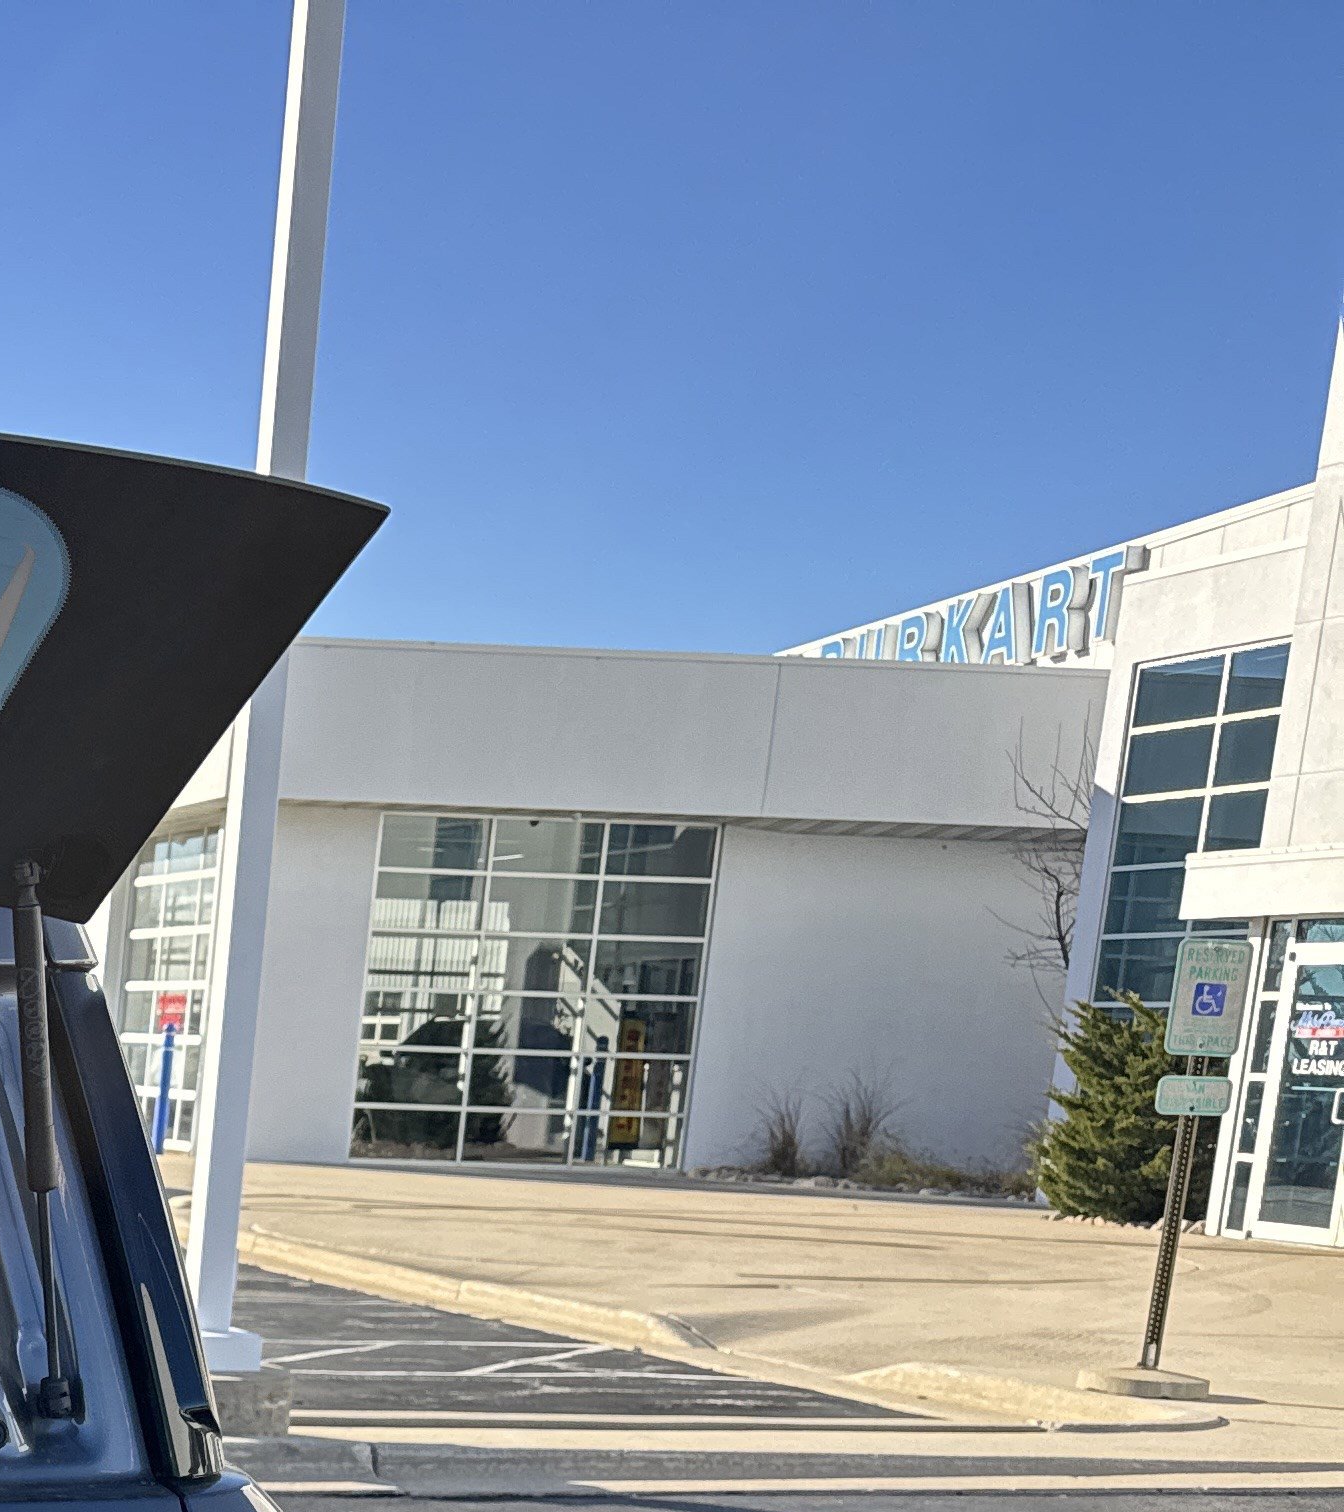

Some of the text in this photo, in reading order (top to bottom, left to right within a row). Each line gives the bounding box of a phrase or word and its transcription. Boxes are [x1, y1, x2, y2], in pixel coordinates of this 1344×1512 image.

[1188, 965, 1239, 982] PARKING
[1200, 1035, 1235, 1049] SPACE
[1309, 1040, 1339, 1056] R&T
[1292, 1058, 1344, 1077] LEASING
